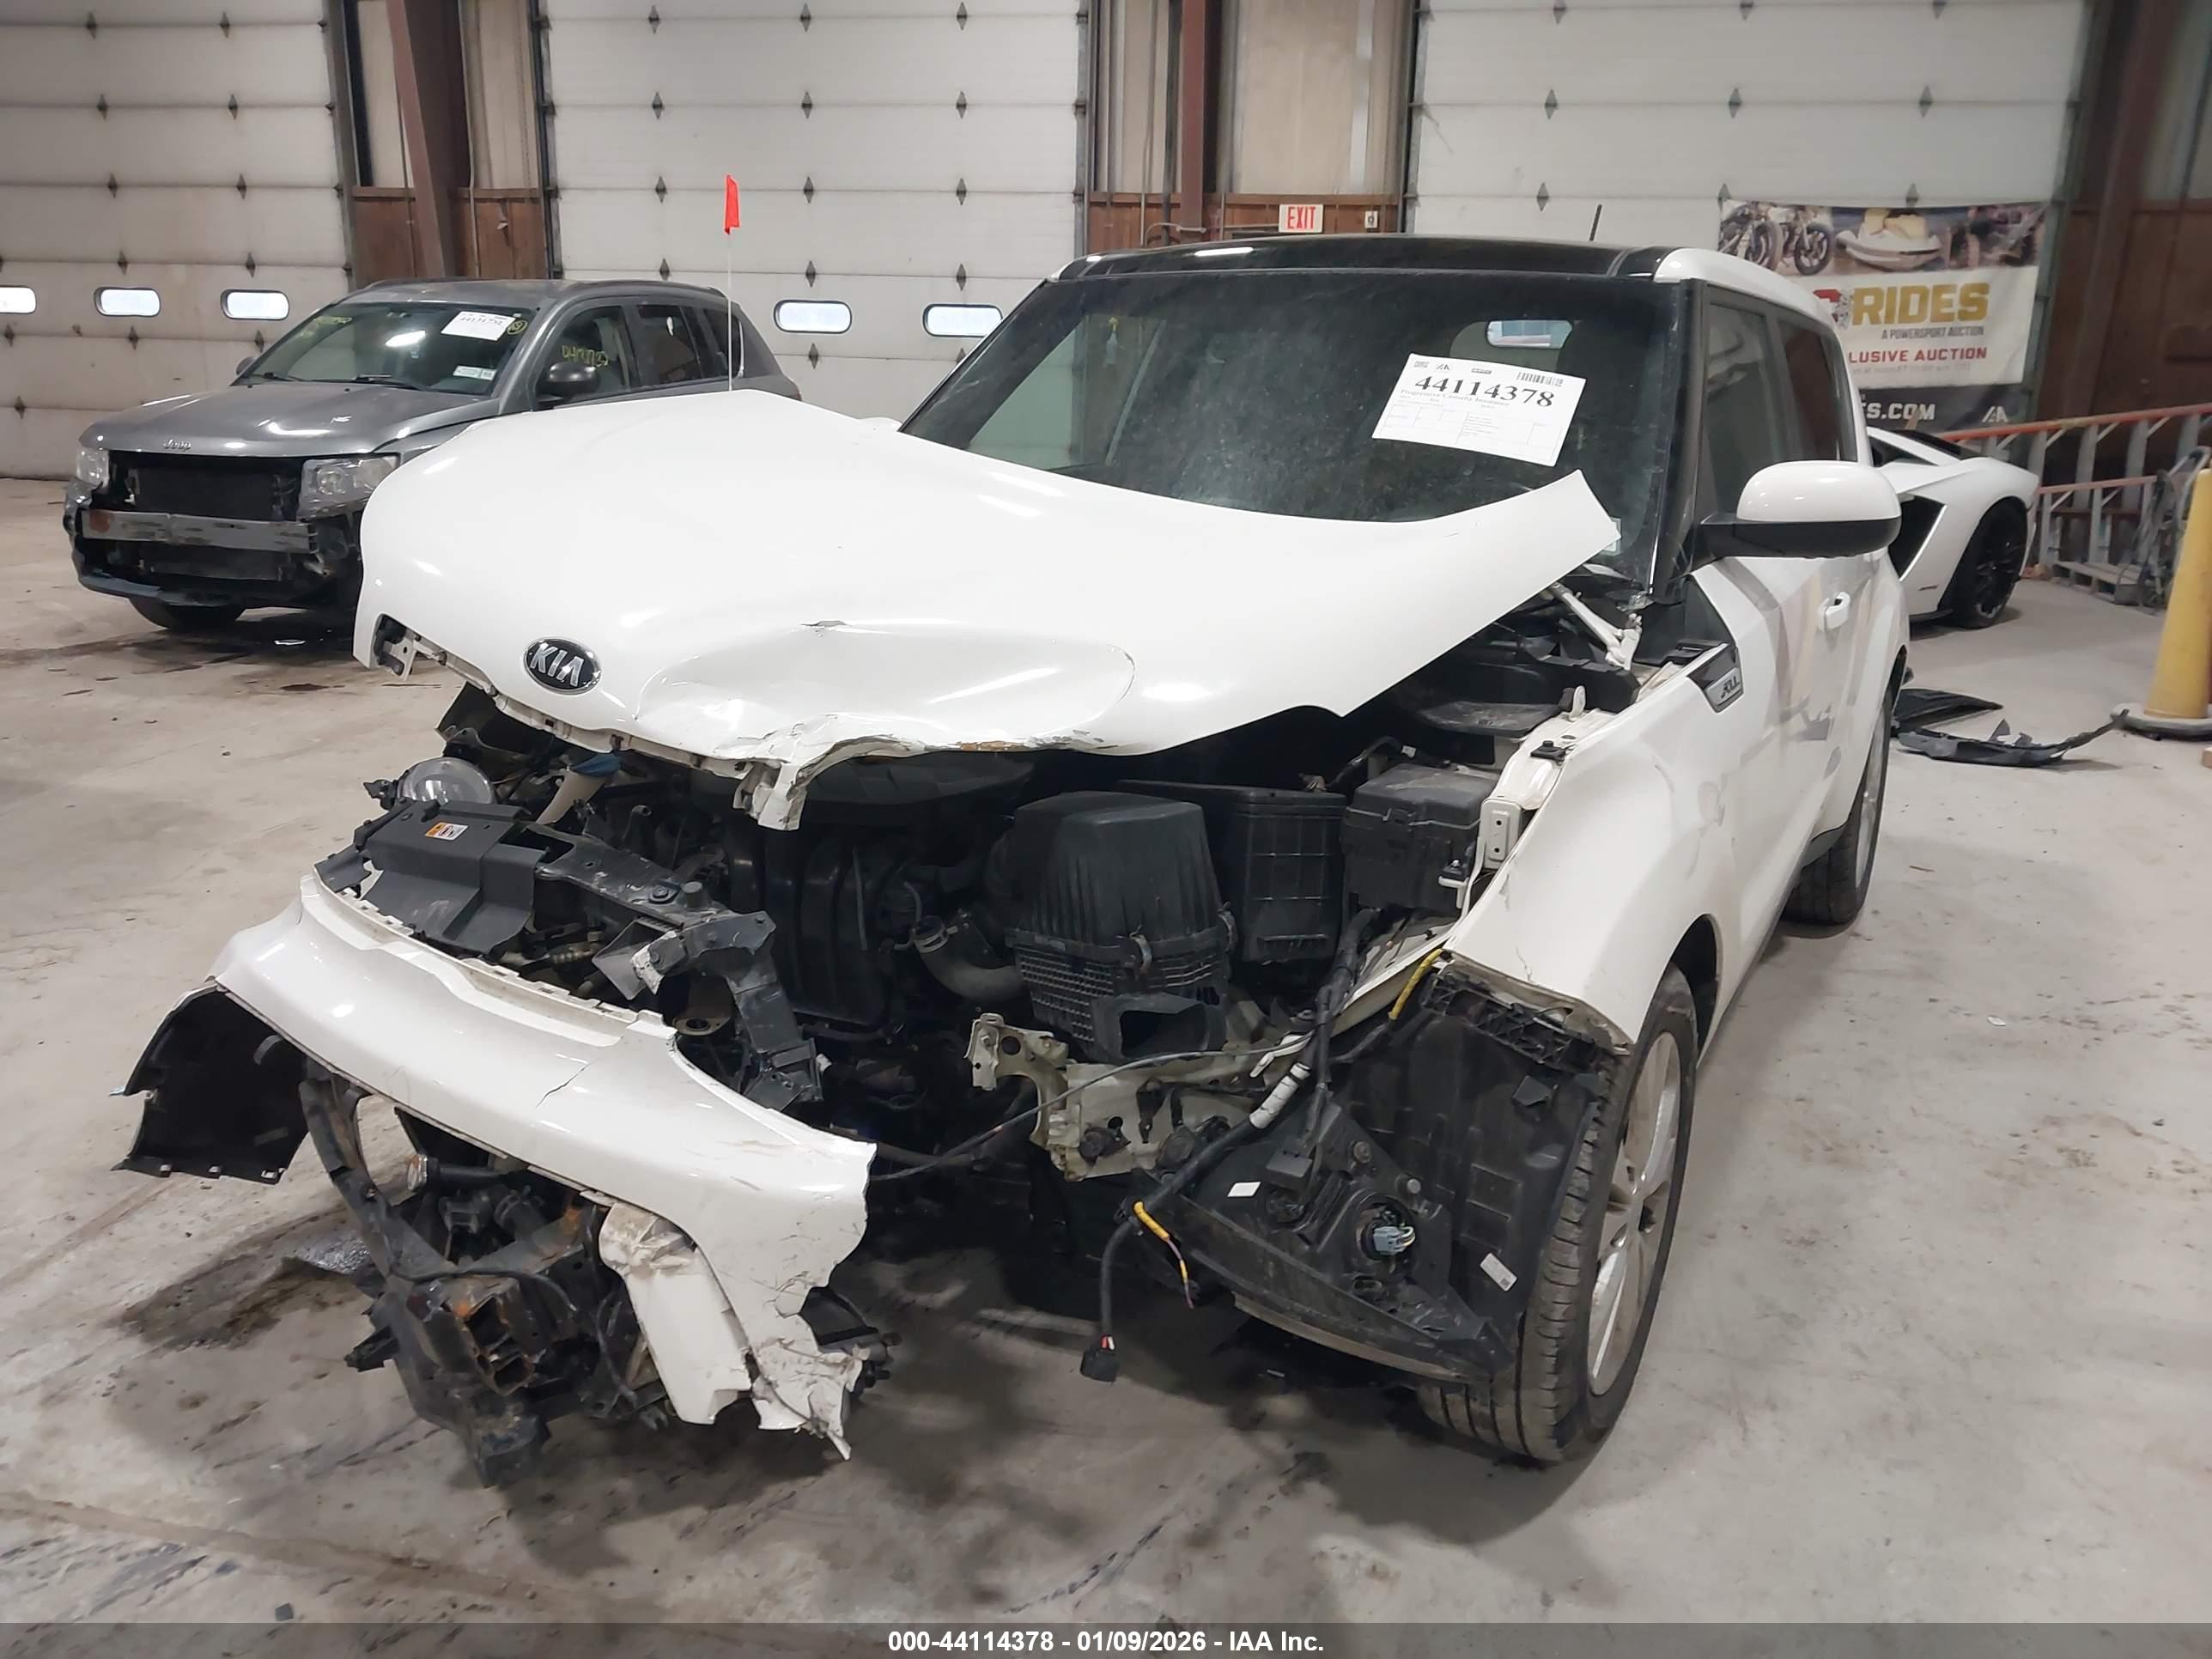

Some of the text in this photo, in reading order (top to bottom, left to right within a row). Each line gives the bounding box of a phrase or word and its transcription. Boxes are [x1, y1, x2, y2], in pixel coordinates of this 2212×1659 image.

[1286, 206, 1316, 229] EXIT
[1851, 283, 1990, 325] RIDES
[1881, 325, 1984, 340] A POWERSPORT AUCTION
[1849, 347, 1987, 363] LUSIVE AUCTION
[1414, 375, 1556, 407] 44114378
[163, 439, 191, 453] Jeep
[529, 642, 585, 687] KIA
